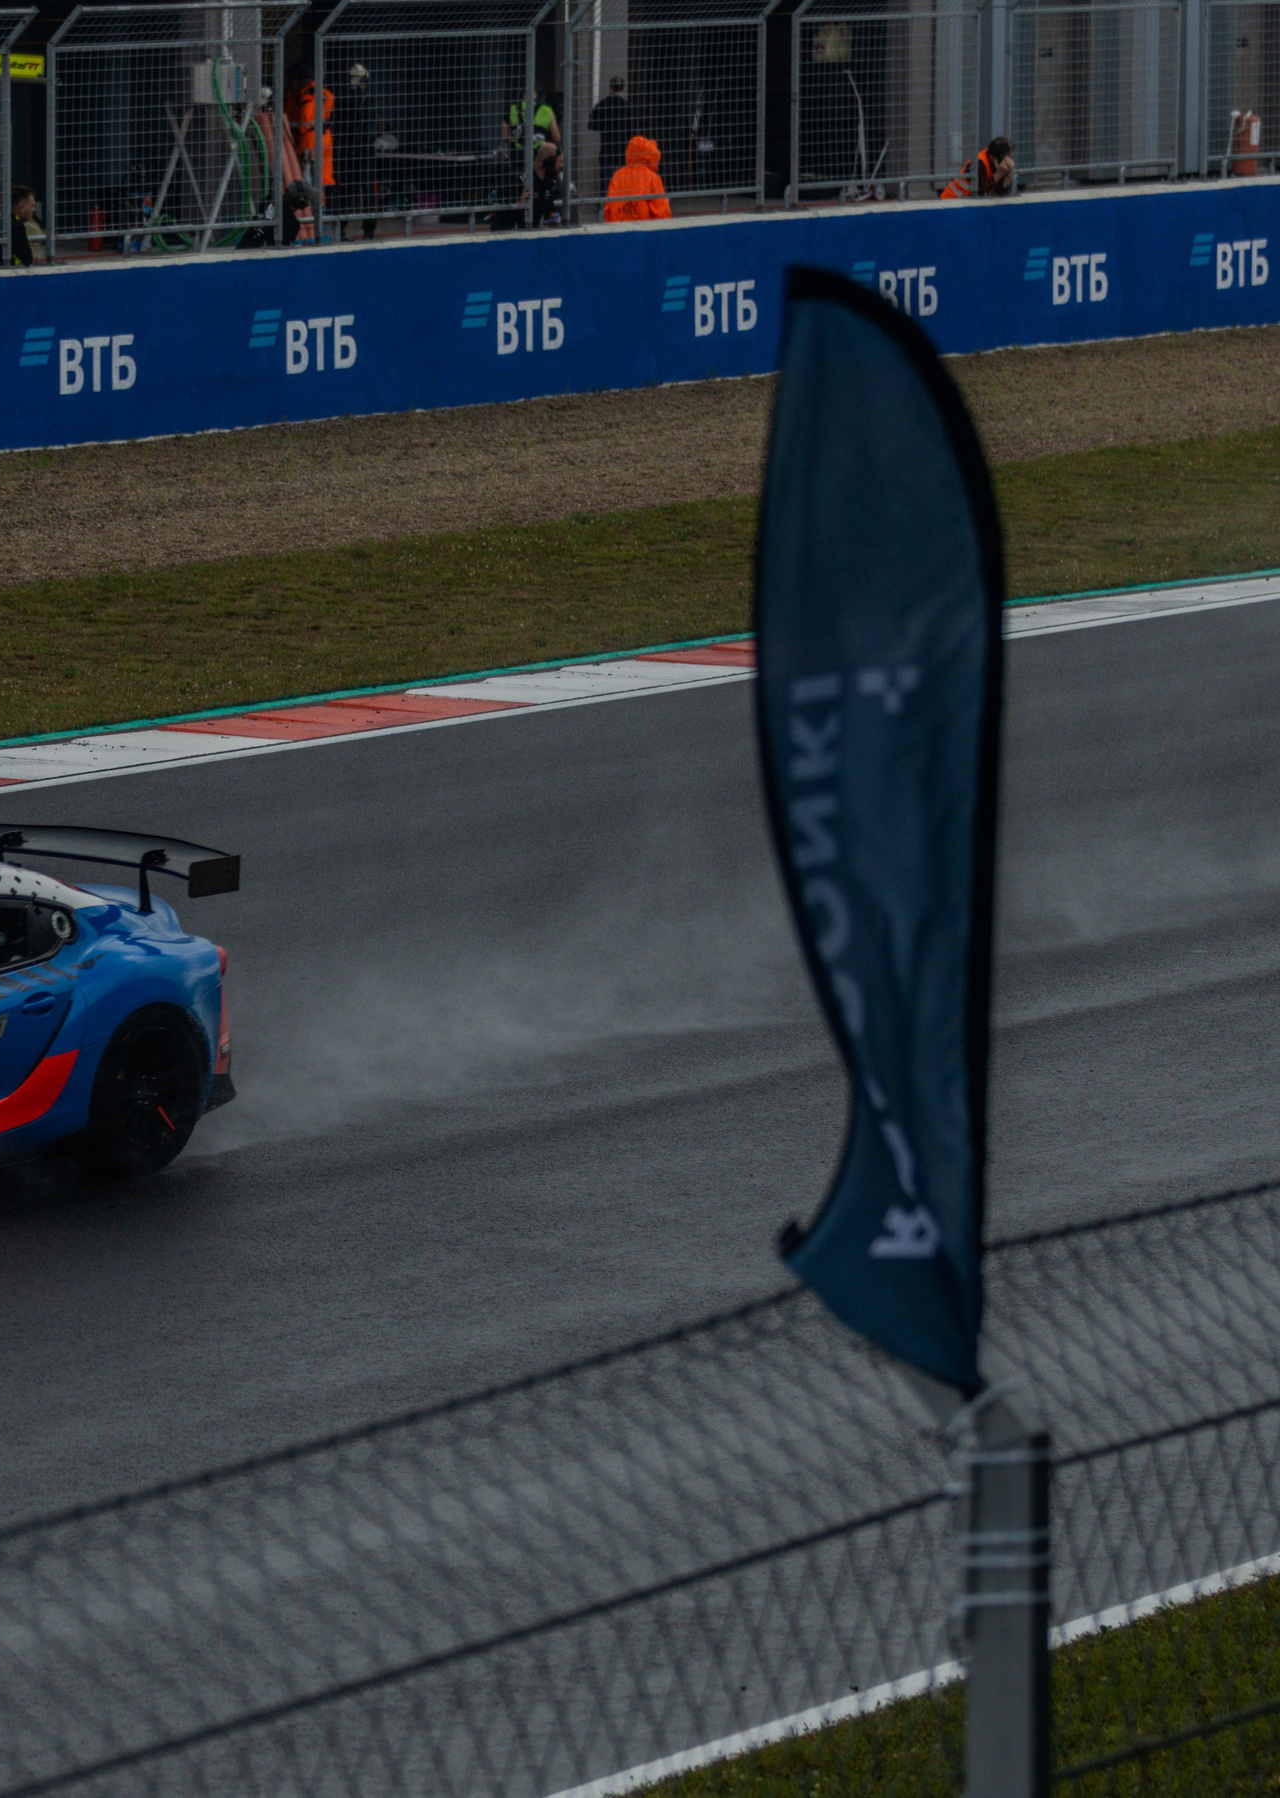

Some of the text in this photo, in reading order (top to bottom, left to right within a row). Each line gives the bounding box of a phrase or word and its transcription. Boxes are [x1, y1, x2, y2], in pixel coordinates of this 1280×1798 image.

[880, 267, 937, 315] ВТБ
[1053, 254, 1107, 304] ВТБ
[1217, 239, 1268, 289] ВТБ
[498, 298, 563, 354] ВТБ
[695, 280, 757, 336] ВТБ
[60, 335, 136, 394] ВТБ
[287, 316, 356, 373] ВТБ
